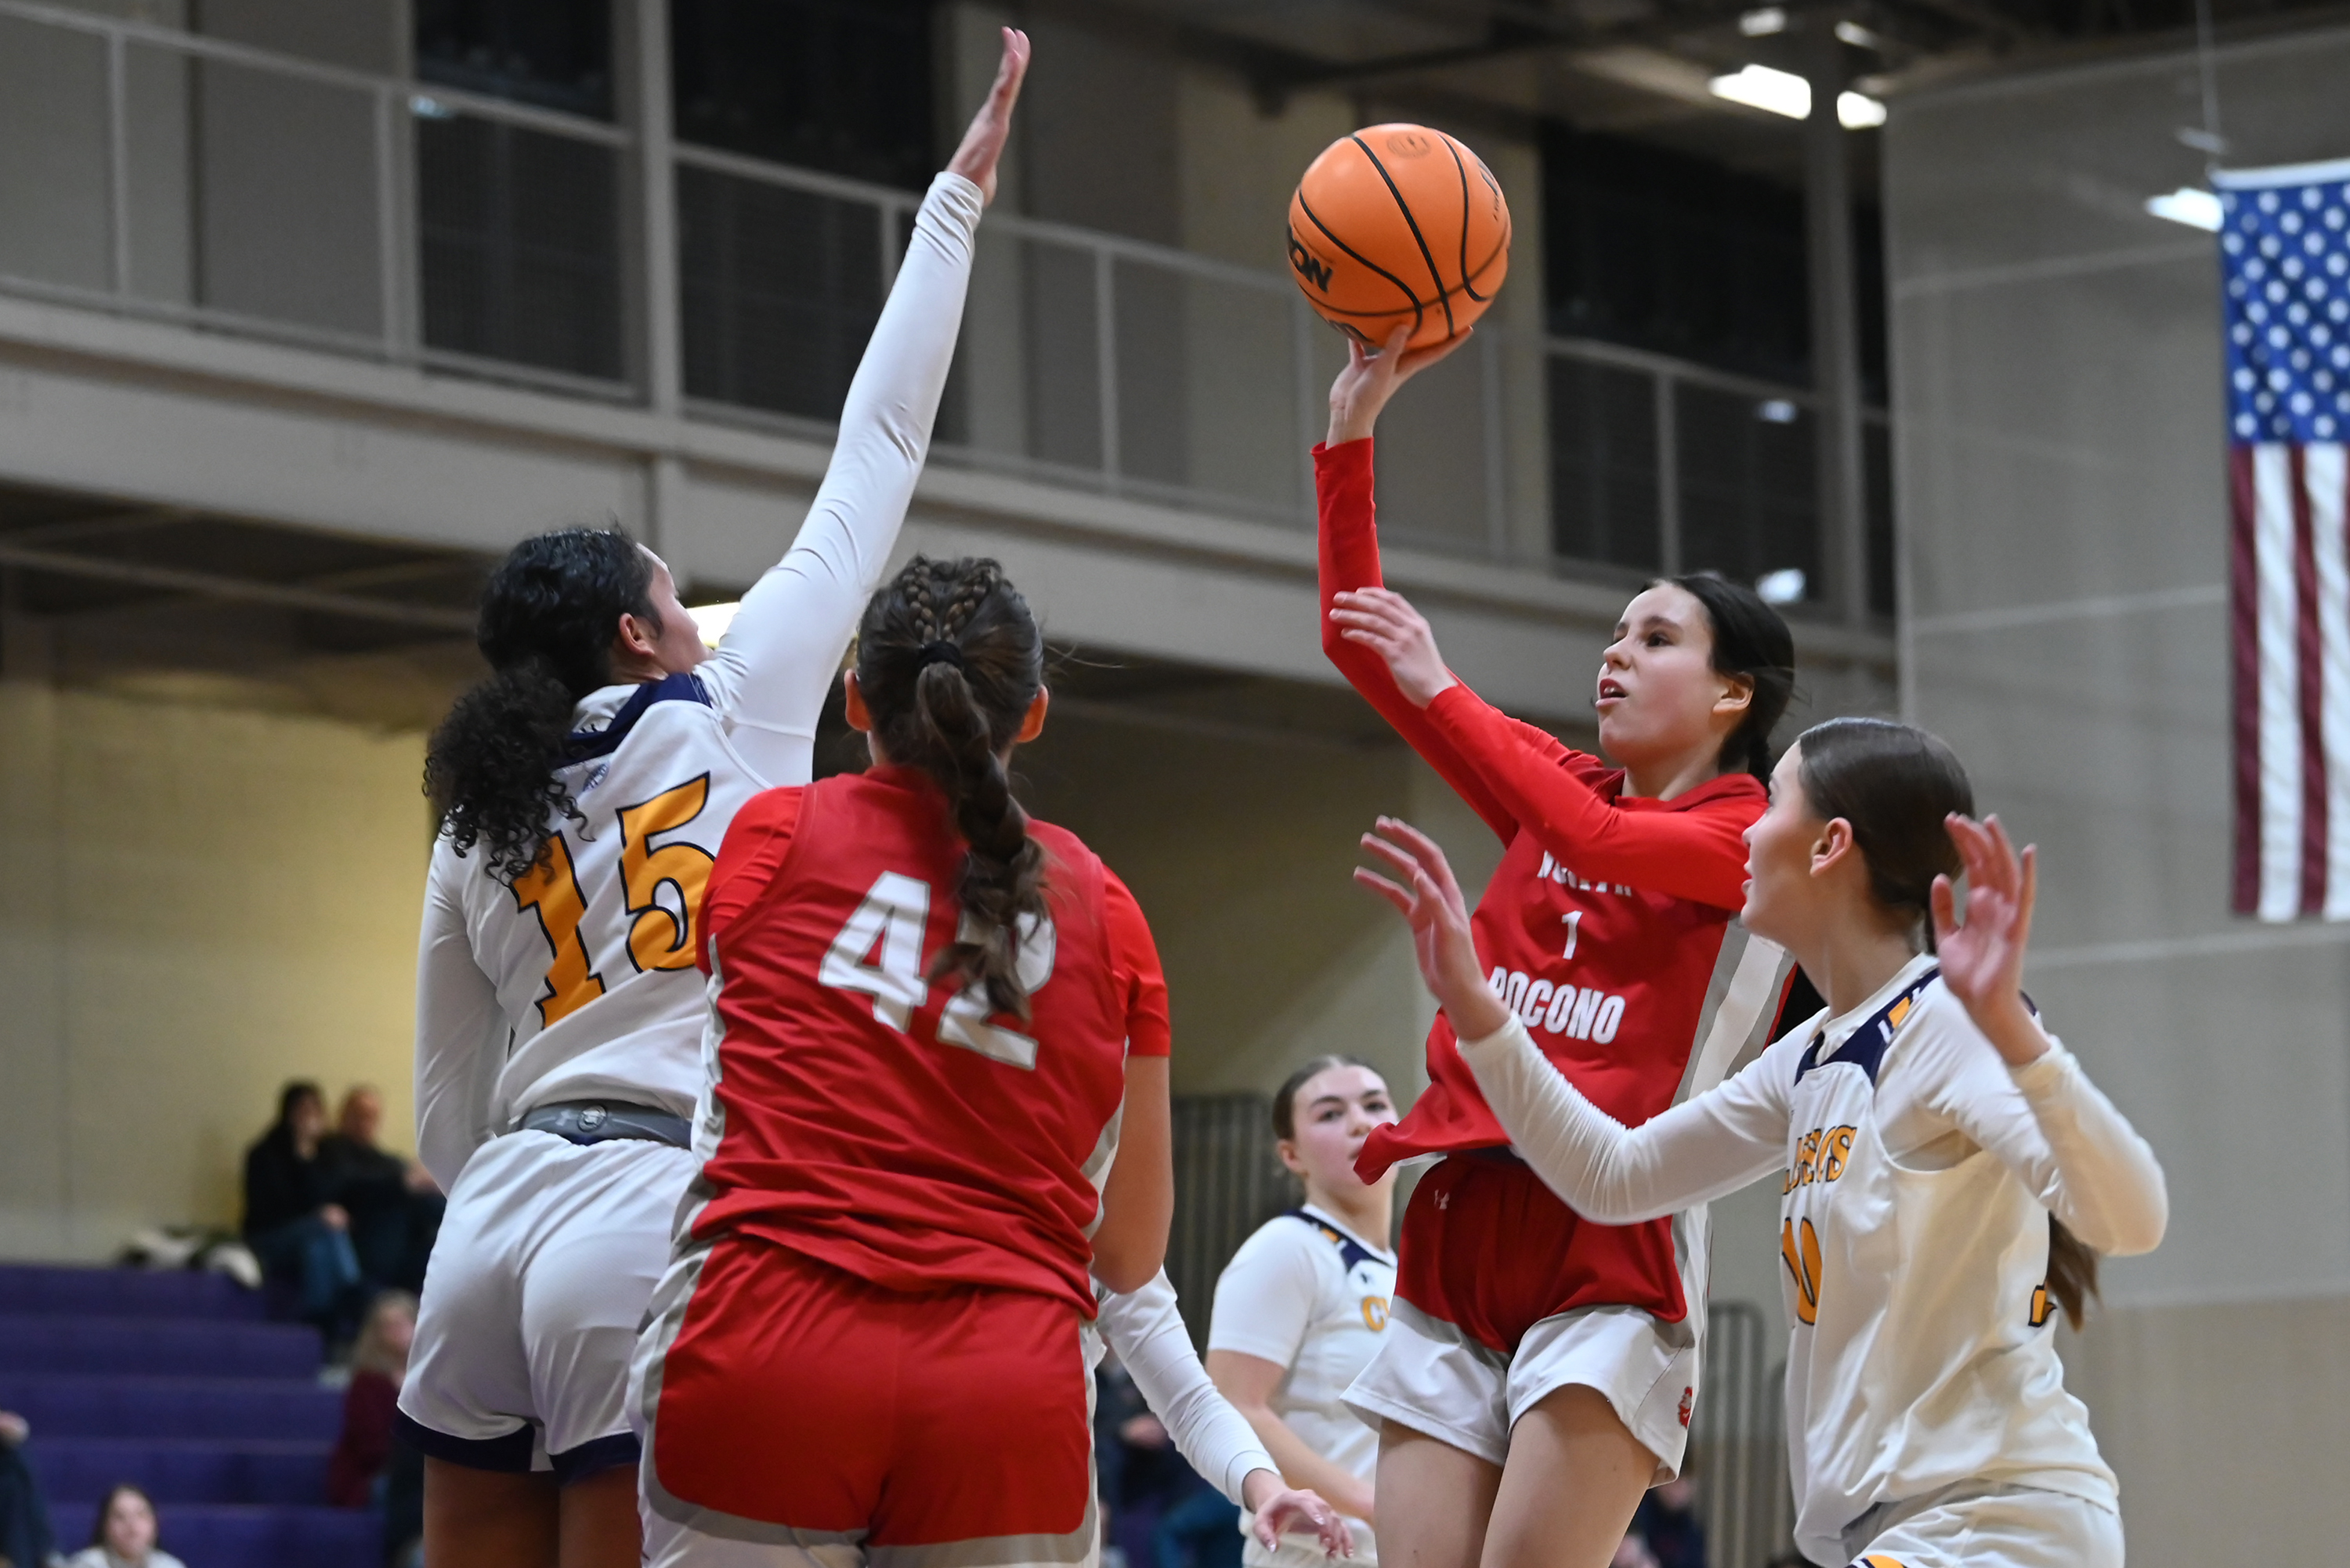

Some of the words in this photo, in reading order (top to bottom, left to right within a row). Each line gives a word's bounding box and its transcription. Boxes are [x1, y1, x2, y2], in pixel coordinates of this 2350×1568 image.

[508, 770, 714, 1031] 15
[818, 869, 1058, 1071] 42
[1561, 910, 1583, 959] 1
[1488, 966, 1625, 1044] POCONO
